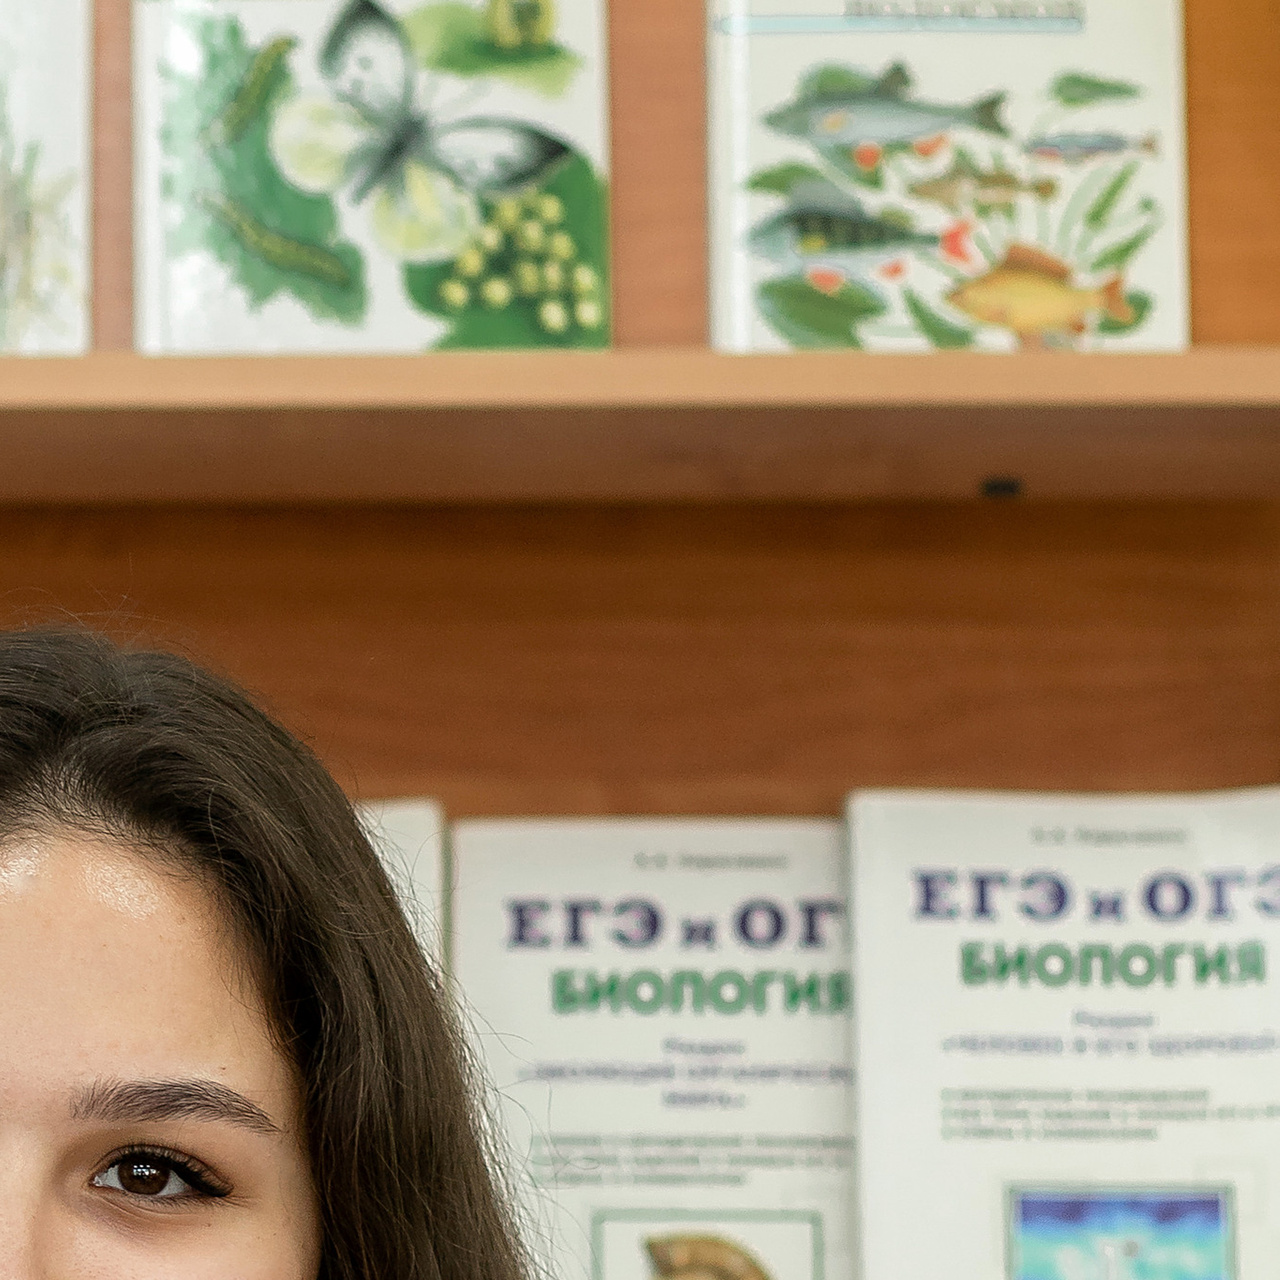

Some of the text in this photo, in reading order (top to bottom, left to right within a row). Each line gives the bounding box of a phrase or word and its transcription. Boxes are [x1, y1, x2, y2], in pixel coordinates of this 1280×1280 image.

[914, 867, 1070, 922] ЕГЭ
[508, 898, 663, 951] ЕГЭ
[959, 939, 1266, 988] БИОЛОГИЯ
